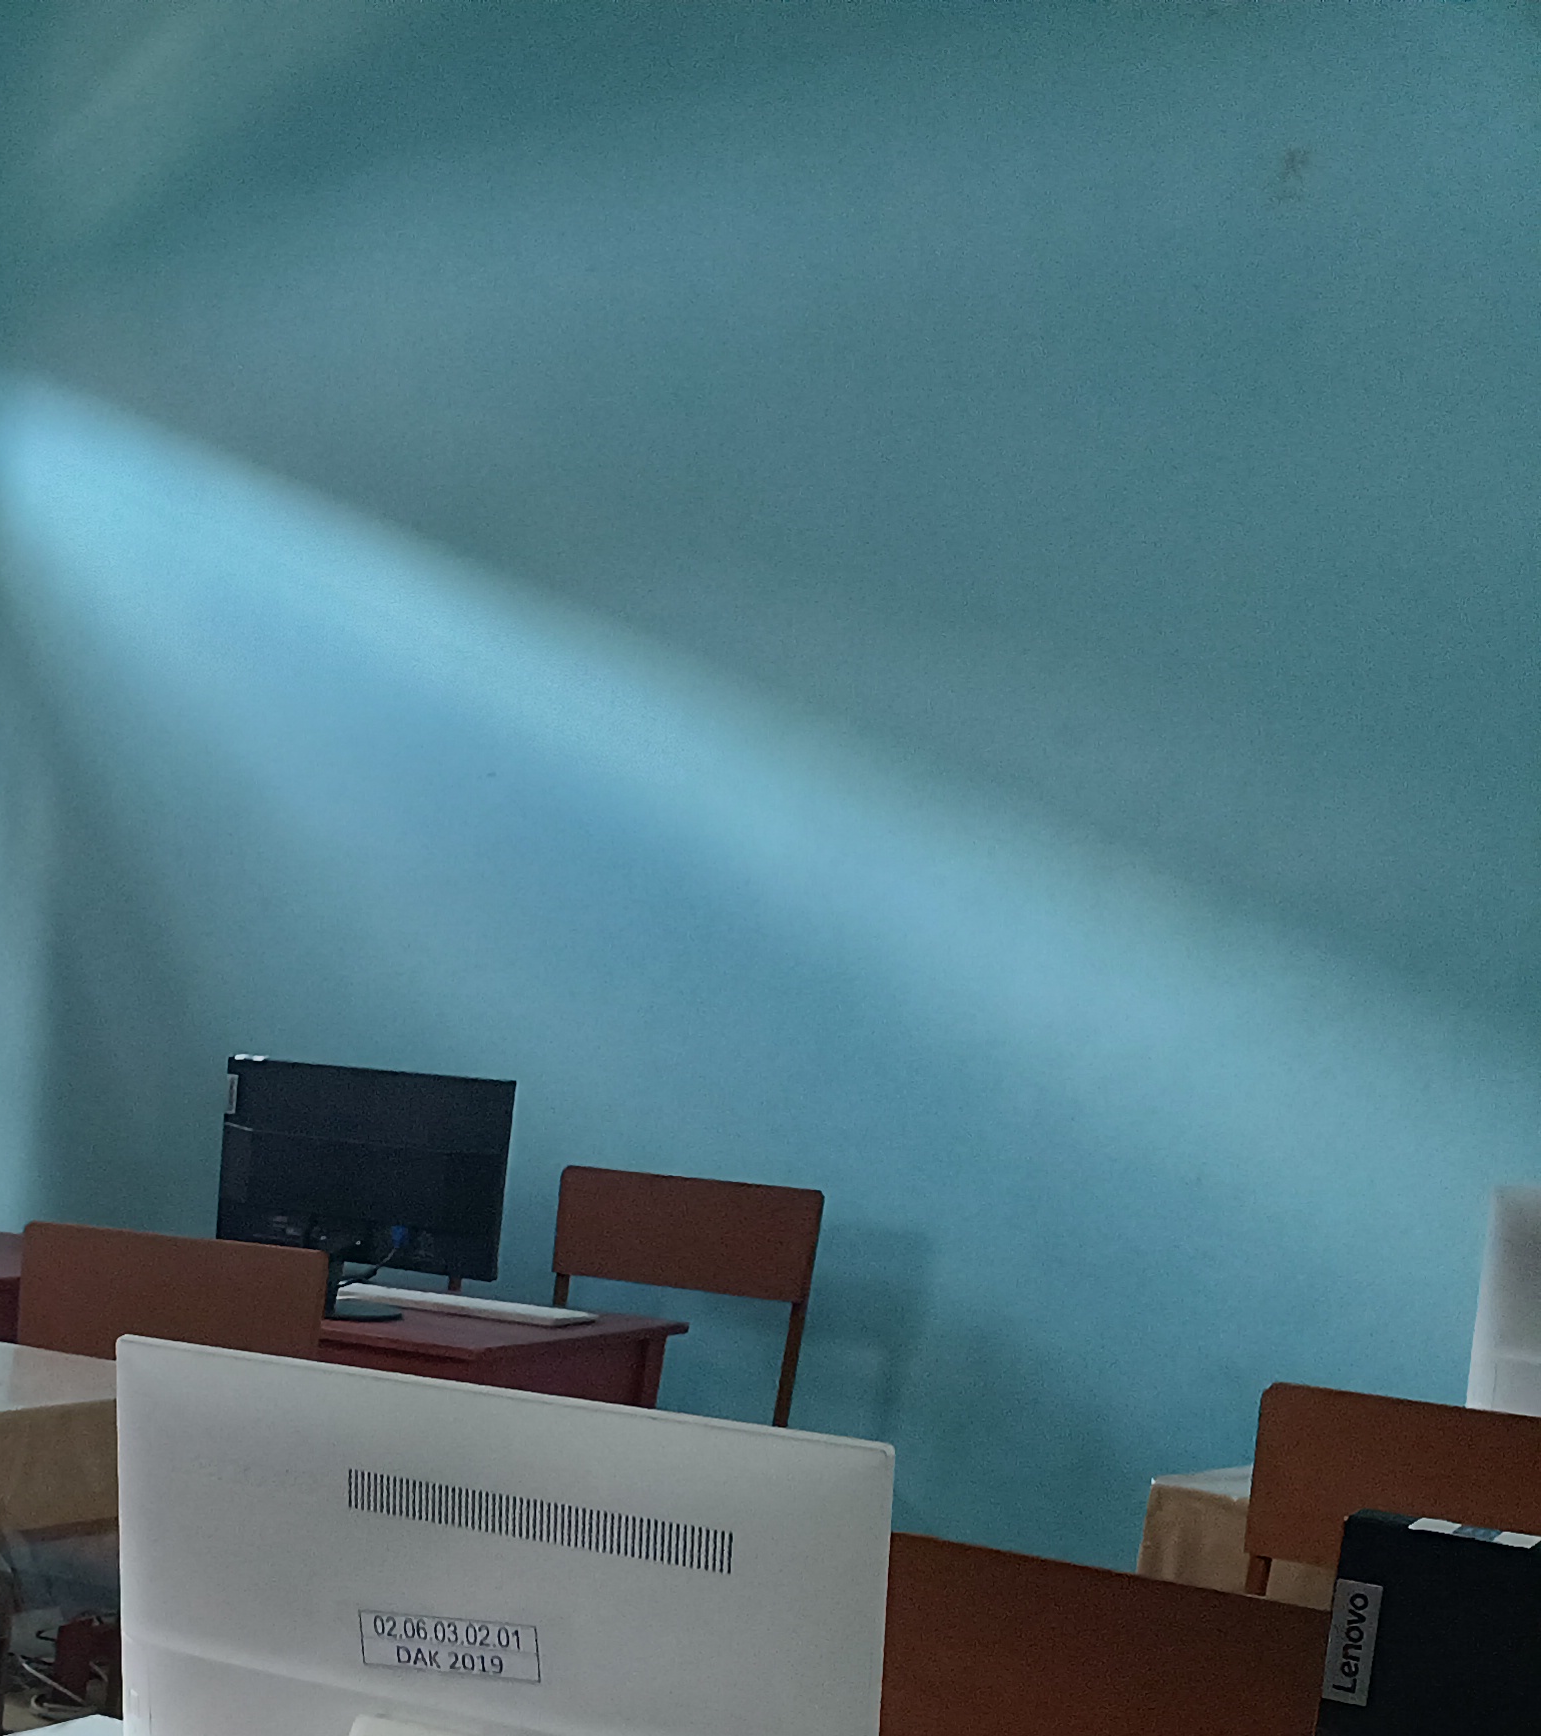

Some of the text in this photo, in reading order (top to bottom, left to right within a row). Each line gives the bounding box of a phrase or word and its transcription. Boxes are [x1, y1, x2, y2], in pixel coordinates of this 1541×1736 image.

[373, 1614, 522, 1651] 02.06.03.02.01
[1332, 1592, 1369, 1695] Lenovo
[396, 1645, 504, 1675] DAK 2019
